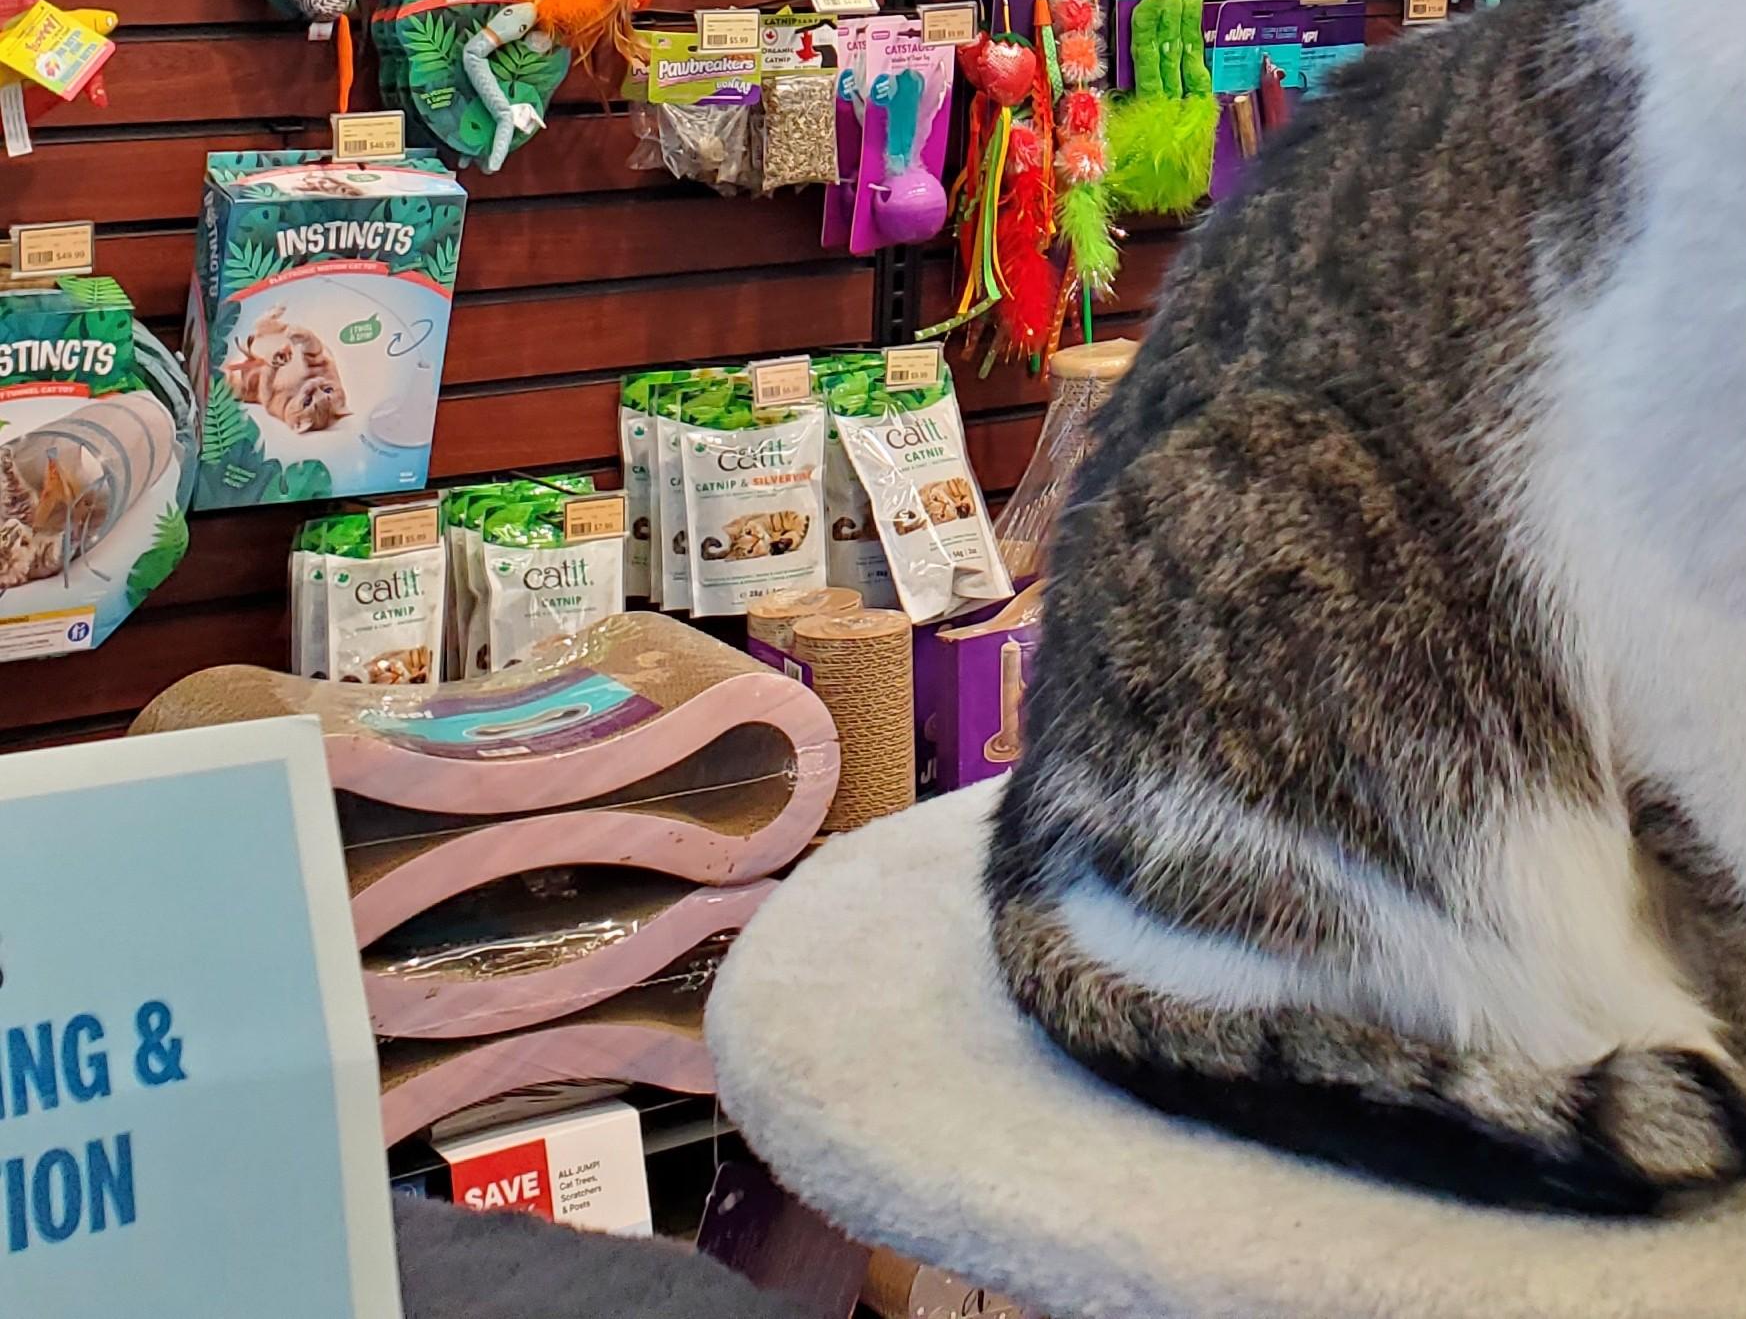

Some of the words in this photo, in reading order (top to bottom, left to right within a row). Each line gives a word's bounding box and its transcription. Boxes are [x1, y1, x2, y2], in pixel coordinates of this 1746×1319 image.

[764, 17, 797, 26] CATNIP
[659, 56, 755, 79] Pawbreakers
[764, 56, 791, 64] CATNIP
[276, 220, 415, 259] INSTINCTS
[0, 338, 116, 377] STINCTS
[904, 447, 945, 463] CATNIP
[696, 479, 737, 492] CATNIP
[741, 478, 748, 488] &
[372, 605, 416, 621] CATNIP
[0, 1013, 111, 1119] NG
[135, 1000, 188, 1085] &
[558, 1167, 574, 1179] ALL
[0, 1132, 136, 1254] ION
[464, 1170, 541, 1211] SAVE
[559, 1180, 574, 1191] Cat
[560, 1184, 602, 1203] Scratchers
[562, 1204, 568, 1214] &
[569, 1200, 591, 1213] Posts
